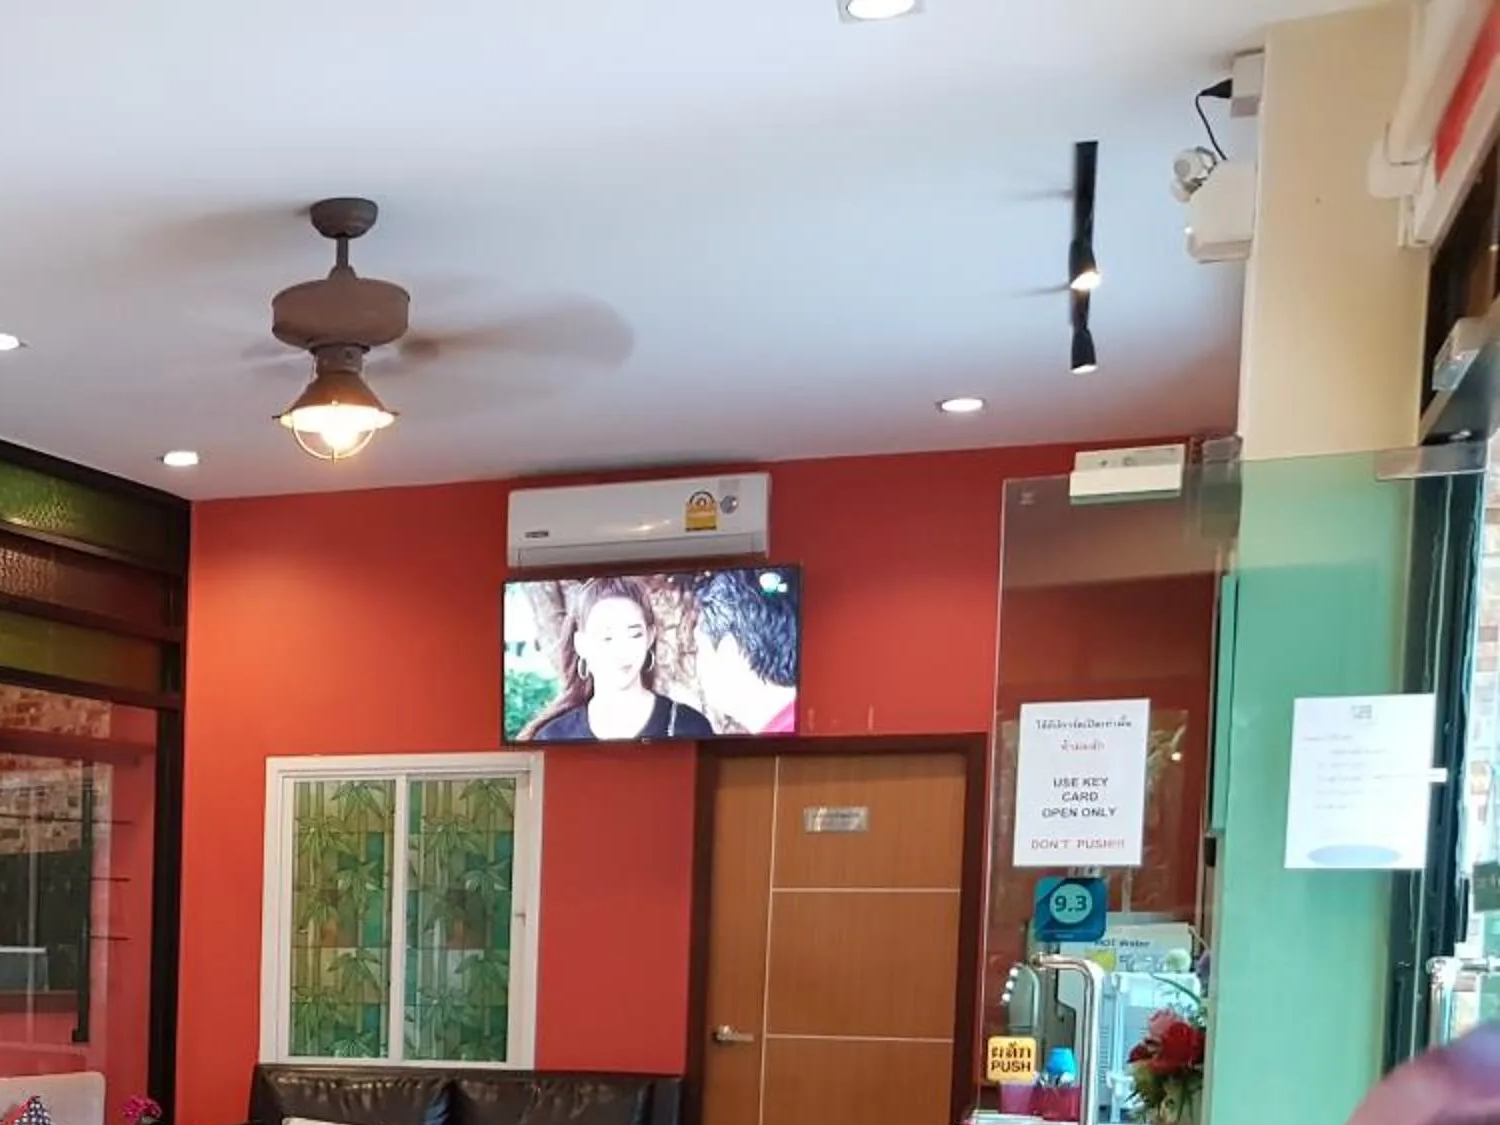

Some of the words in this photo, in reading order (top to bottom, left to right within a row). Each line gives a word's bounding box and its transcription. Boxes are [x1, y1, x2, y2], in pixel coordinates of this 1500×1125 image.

[1053, 777, 1079, 788] USE
[1082, 777, 1109, 788] KEY
[1061, 791, 1099, 802] CARD
[1041, 808, 1078, 819] OPEN
[1081, 807, 1117, 818] ONLY
[1054, 894, 1088, 912] 9.3
[991, 1041, 1031, 1058] ผลัก
[991, 1060, 1031, 1073] PUSH
